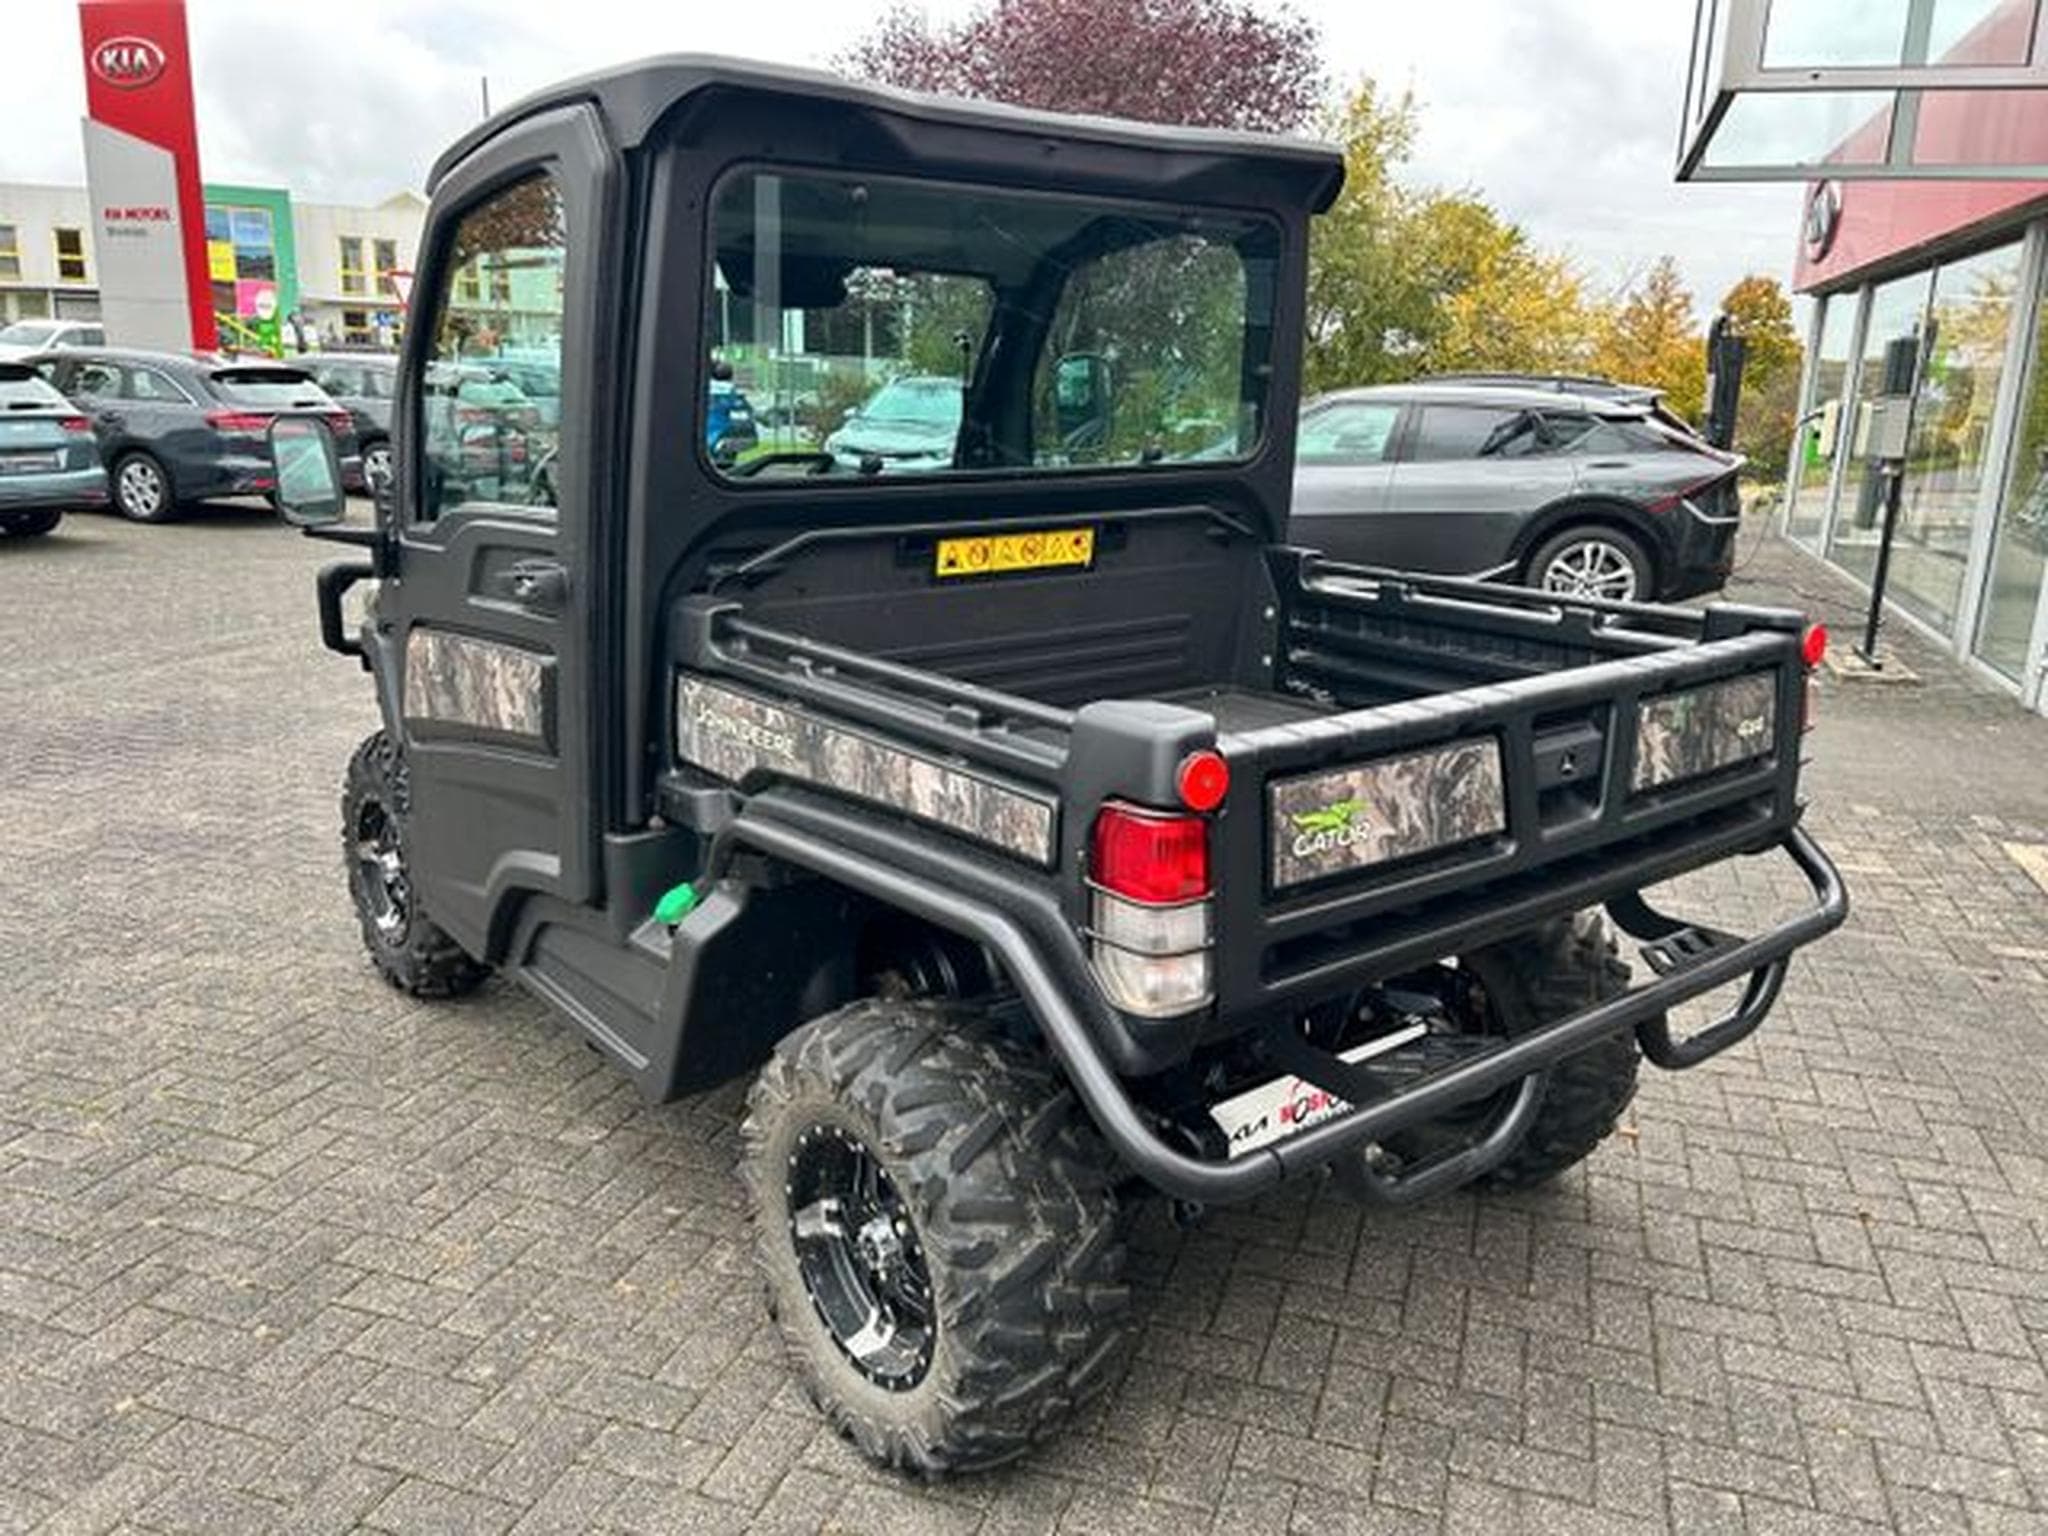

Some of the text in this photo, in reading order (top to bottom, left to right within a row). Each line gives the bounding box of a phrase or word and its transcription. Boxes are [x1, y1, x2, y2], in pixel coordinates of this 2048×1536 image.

[102, 47, 152, 74] KIA
[126, 207, 170, 221] MOTORS
[1292, 822, 1371, 857] GATOR
